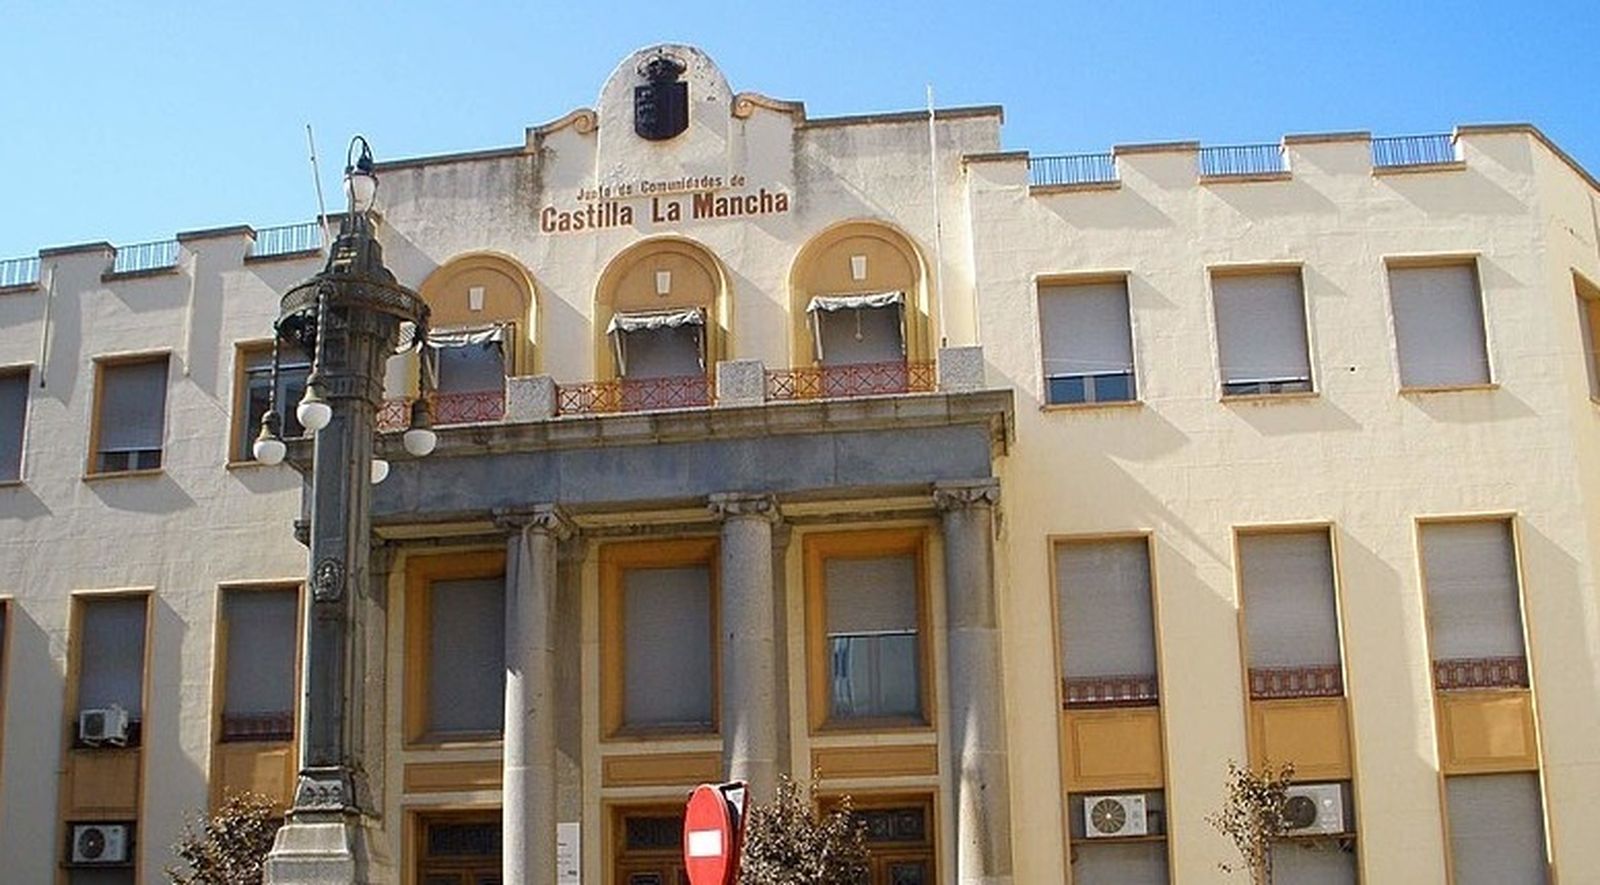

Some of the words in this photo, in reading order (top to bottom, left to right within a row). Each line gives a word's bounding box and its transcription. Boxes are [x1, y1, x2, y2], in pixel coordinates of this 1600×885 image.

[618, 183, 632, 196] de
[641, 176, 722, 193] Comunidades
[542, 203, 633, 232] Castilla
[652, 197, 681, 223] La
[693, 189, 788, 219] Mancha
